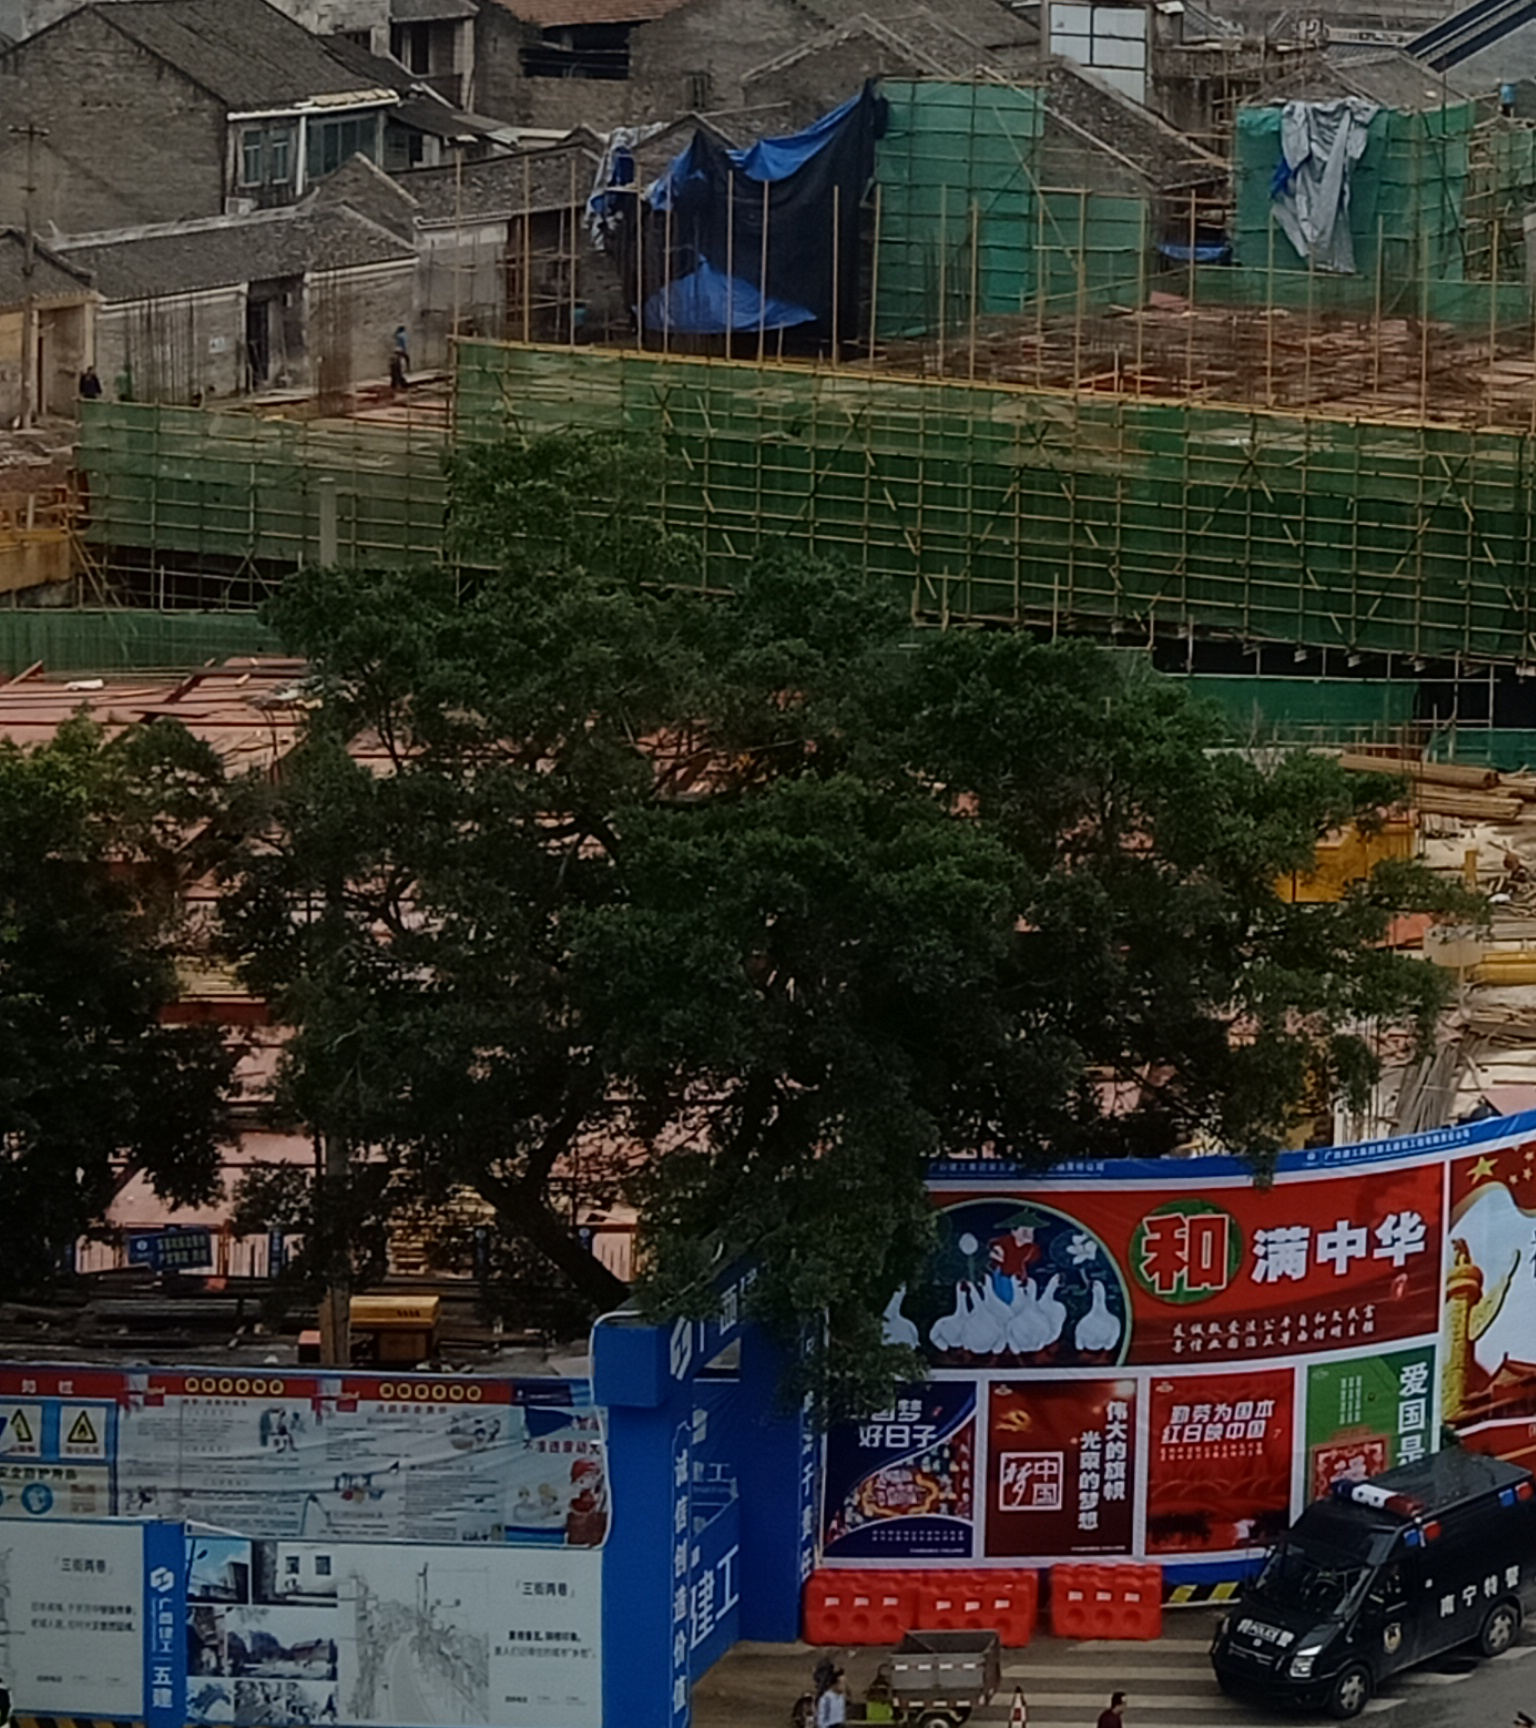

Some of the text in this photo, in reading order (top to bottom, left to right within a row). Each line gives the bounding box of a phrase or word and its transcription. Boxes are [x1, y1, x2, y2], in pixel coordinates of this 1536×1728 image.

[1141, 1210, 1428, 1295] 和 满中华
[1161, 1420, 1266, 1445] 红日映中国
[1170, 1399, 1275, 1425] 勤劳为国本
[858, 1424, 938, 1449] 好日子
[1103, 1400, 1129, 1501] 伟大的旗帜
[1078, 1430, 1102, 1531] 光荣的梦想
[1440, 1564, 1520, 1617] 南宁特警
[152, 1666, 173, 1708] 五建
